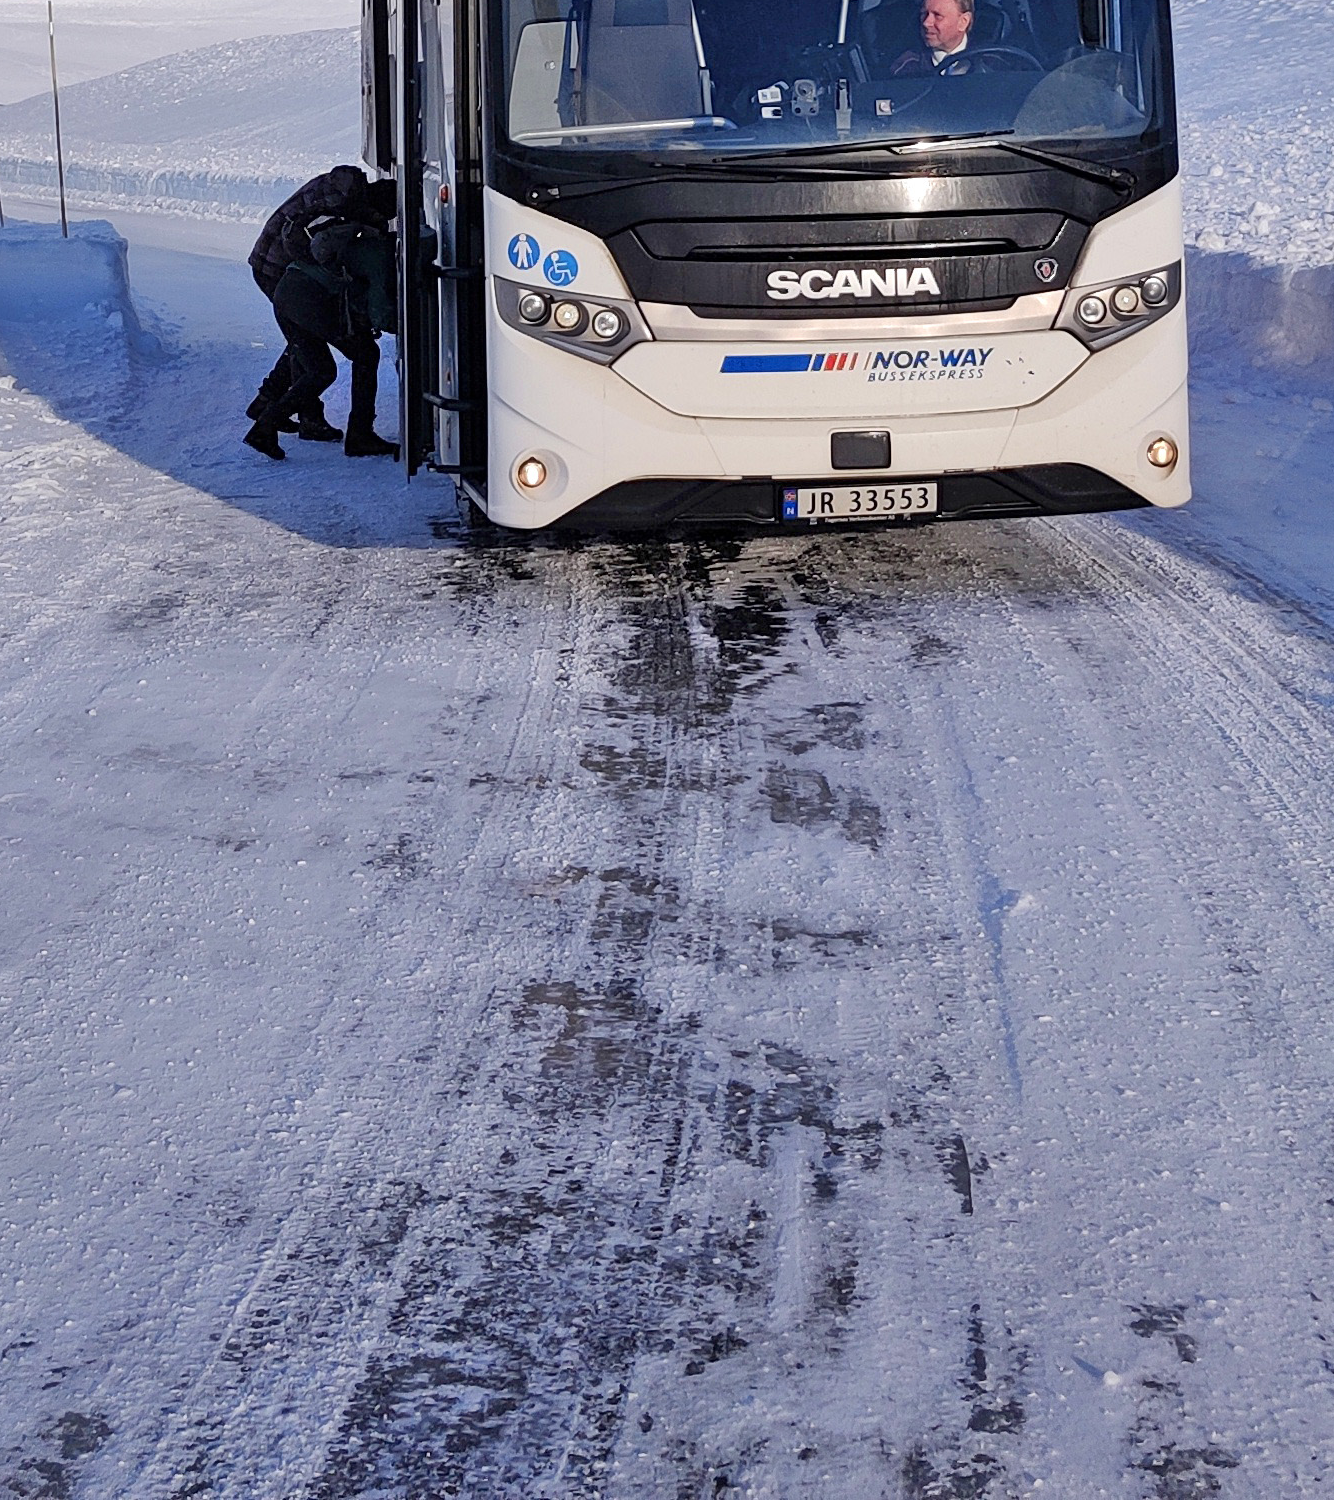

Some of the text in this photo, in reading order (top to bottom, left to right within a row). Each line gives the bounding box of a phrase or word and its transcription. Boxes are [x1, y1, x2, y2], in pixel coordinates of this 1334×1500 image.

[767, 267, 941, 300] SCANIA
[871, 347, 994, 370] NOR-WAY
[867, 368, 985, 383] BUSSEKSPRESS
[786, 506, 795, 515] N
[807, 487, 929, 515] JR 33553
